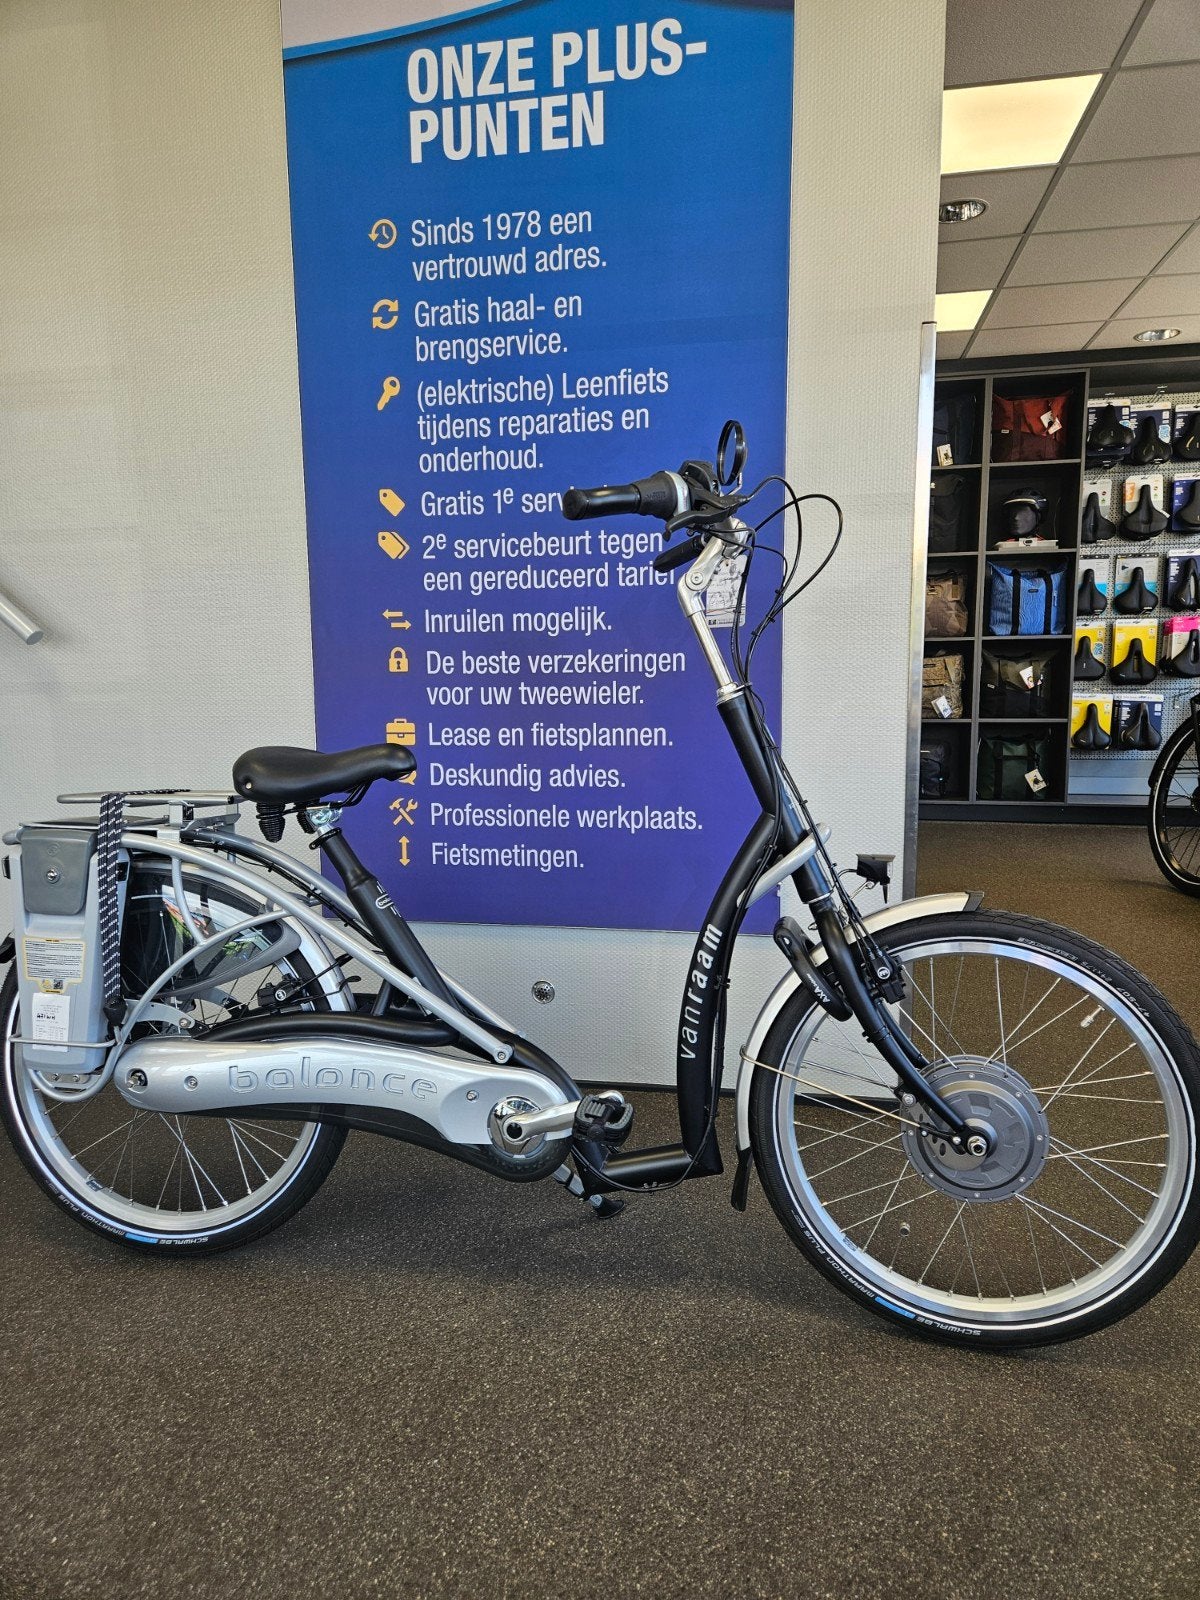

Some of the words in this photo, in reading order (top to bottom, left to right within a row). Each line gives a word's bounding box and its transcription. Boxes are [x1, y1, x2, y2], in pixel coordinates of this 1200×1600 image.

[408, 37, 534, 103] ONZE
[553, 19, 706, 87] PLUS-
[410, 91, 603, 163] PUNTEN
[412, 217, 473, 246] Sinds
[483, 211, 541, 240] 1978
[550, 211, 591, 235] een
[413, 247, 526, 281] vertrouwd
[535, 244, 606, 272] adres.
[415, 299, 479, 327] Gratis
[488, 294, 545, 322] haal-
[555, 296, 581, 318] en
[416, 329, 567, 364] brengservice.
[418, 374, 553, 412] (elektrische)
[563, 368, 668, 398] Leenfiets
[418, 414, 491, 445] tijdens
[500, 406, 613, 441] reparaties
[622, 409, 648, 429] en
[420, 443, 543, 473] onderhoud.
[422, 491, 484, 516] Gratis
[454, 531, 591, 558] servicebeurt
[598, 530, 662, 559] tegen
[424, 572, 461, 591] een
[470, 562, 608, 595] gereduceerd
[425, 609, 503, 632] Inruilen
[513, 606, 611, 636] mogelijk.
[427, 651, 454, 674] De
[463, 651, 520, 674] beste
[528, 649, 685, 678] verzekeringen
[427, 687, 473, 705] voor
[481, 687, 512, 705] uw
[519, 681, 643, 705] tweewieler.
[429, 723, 490, 746] Lease
[498, 728, 523, 746] en
[531, 722, 672, 751] fietsplannen.
[430, 763, 541, 791] Deskundig
[550, 764, 625, 787] advies.
[431, 803, 569, 827] Professionele
[577, 806, 702, 834] werkplaats.
[432, 843, 583, 872] Fietsmetingen.
[813, 985, 831, 1003] AXA
[228, 1056, 438, 1100] balance
[57, 1193, 80, 1212] PLUS
[81, 1212, 126, 1236] MARATHON
[159, 1236, 209, 1245] SCHWALBE
[803, 1229, 826, 1255] PLUS
[826, 1256, 875, 1298] MARATHON
[915, 1315, 982, 1336] SCHWALBE
